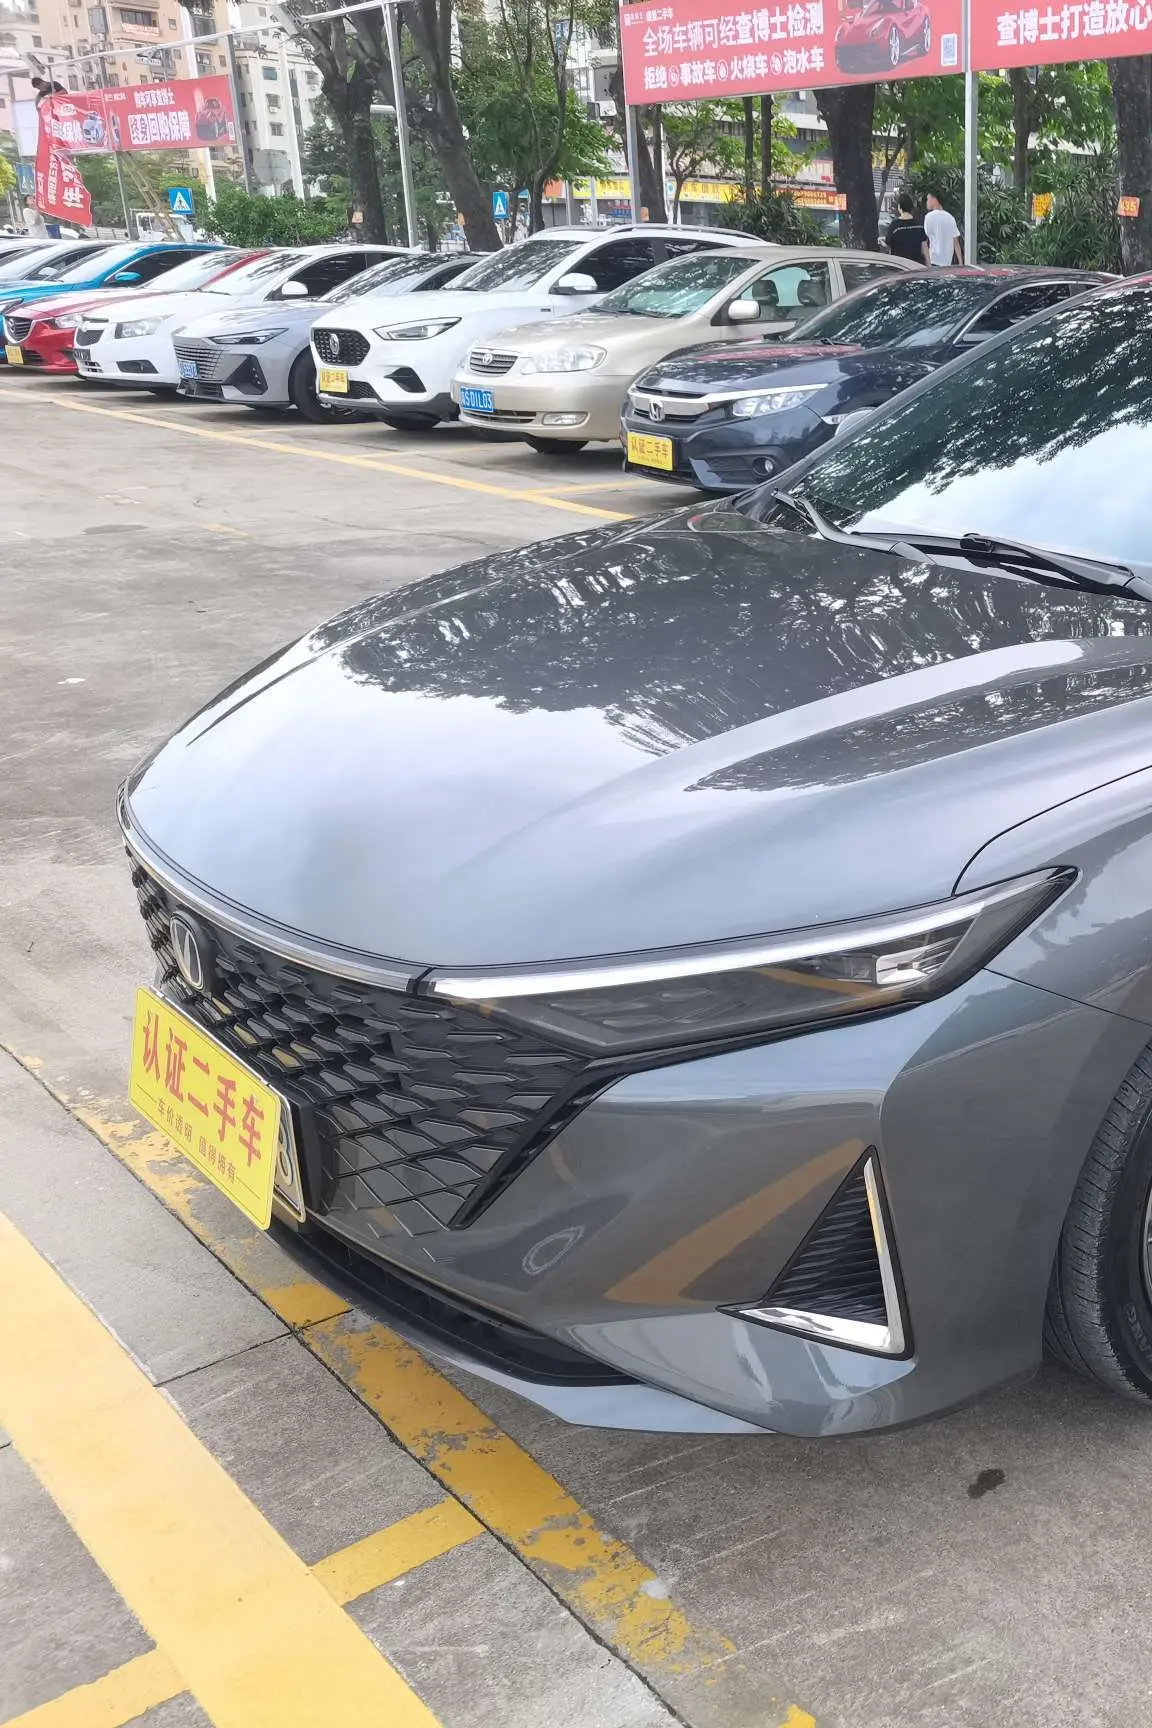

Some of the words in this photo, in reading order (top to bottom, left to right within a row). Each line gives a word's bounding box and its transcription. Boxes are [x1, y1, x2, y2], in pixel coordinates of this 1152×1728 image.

[643, 1, 824, 57] 全场车辆可经查博士检测
[644, 65, 668, 90] 拒绝
[730, 53, 768, 80] 火烧车
[783, 46, 825, 75] 泡水车
[143, 1010, 265, 1168] 认证二手车
[157, 1098, 193, 1143] 车价透明
